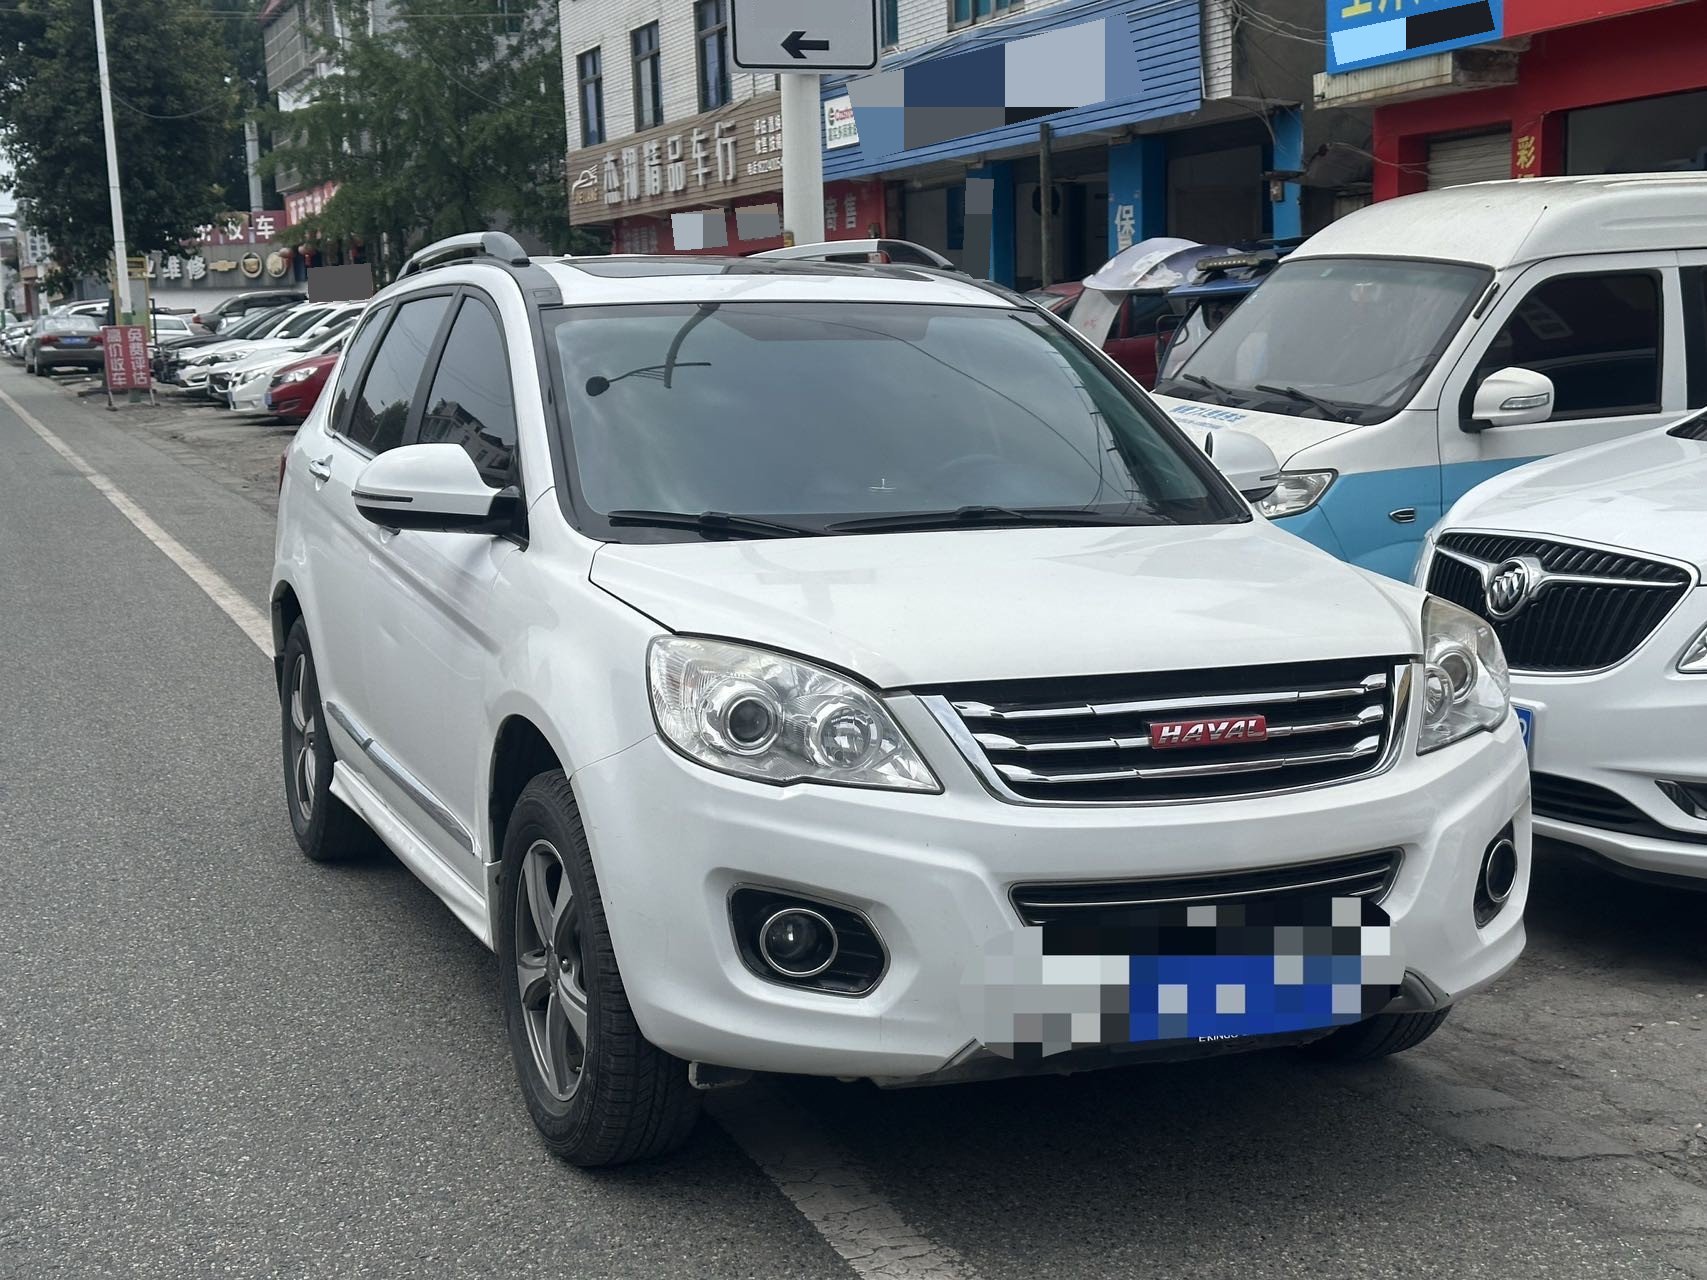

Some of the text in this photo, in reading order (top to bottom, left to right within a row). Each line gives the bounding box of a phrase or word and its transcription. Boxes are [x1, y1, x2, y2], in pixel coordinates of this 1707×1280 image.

[1516, 135, 1535, 178] 彩
[105, 328, 128, 386] 高价收车
[127, 327, 148, 386] 免费评估
[1158, 719, 1265, 745] HAVAL
